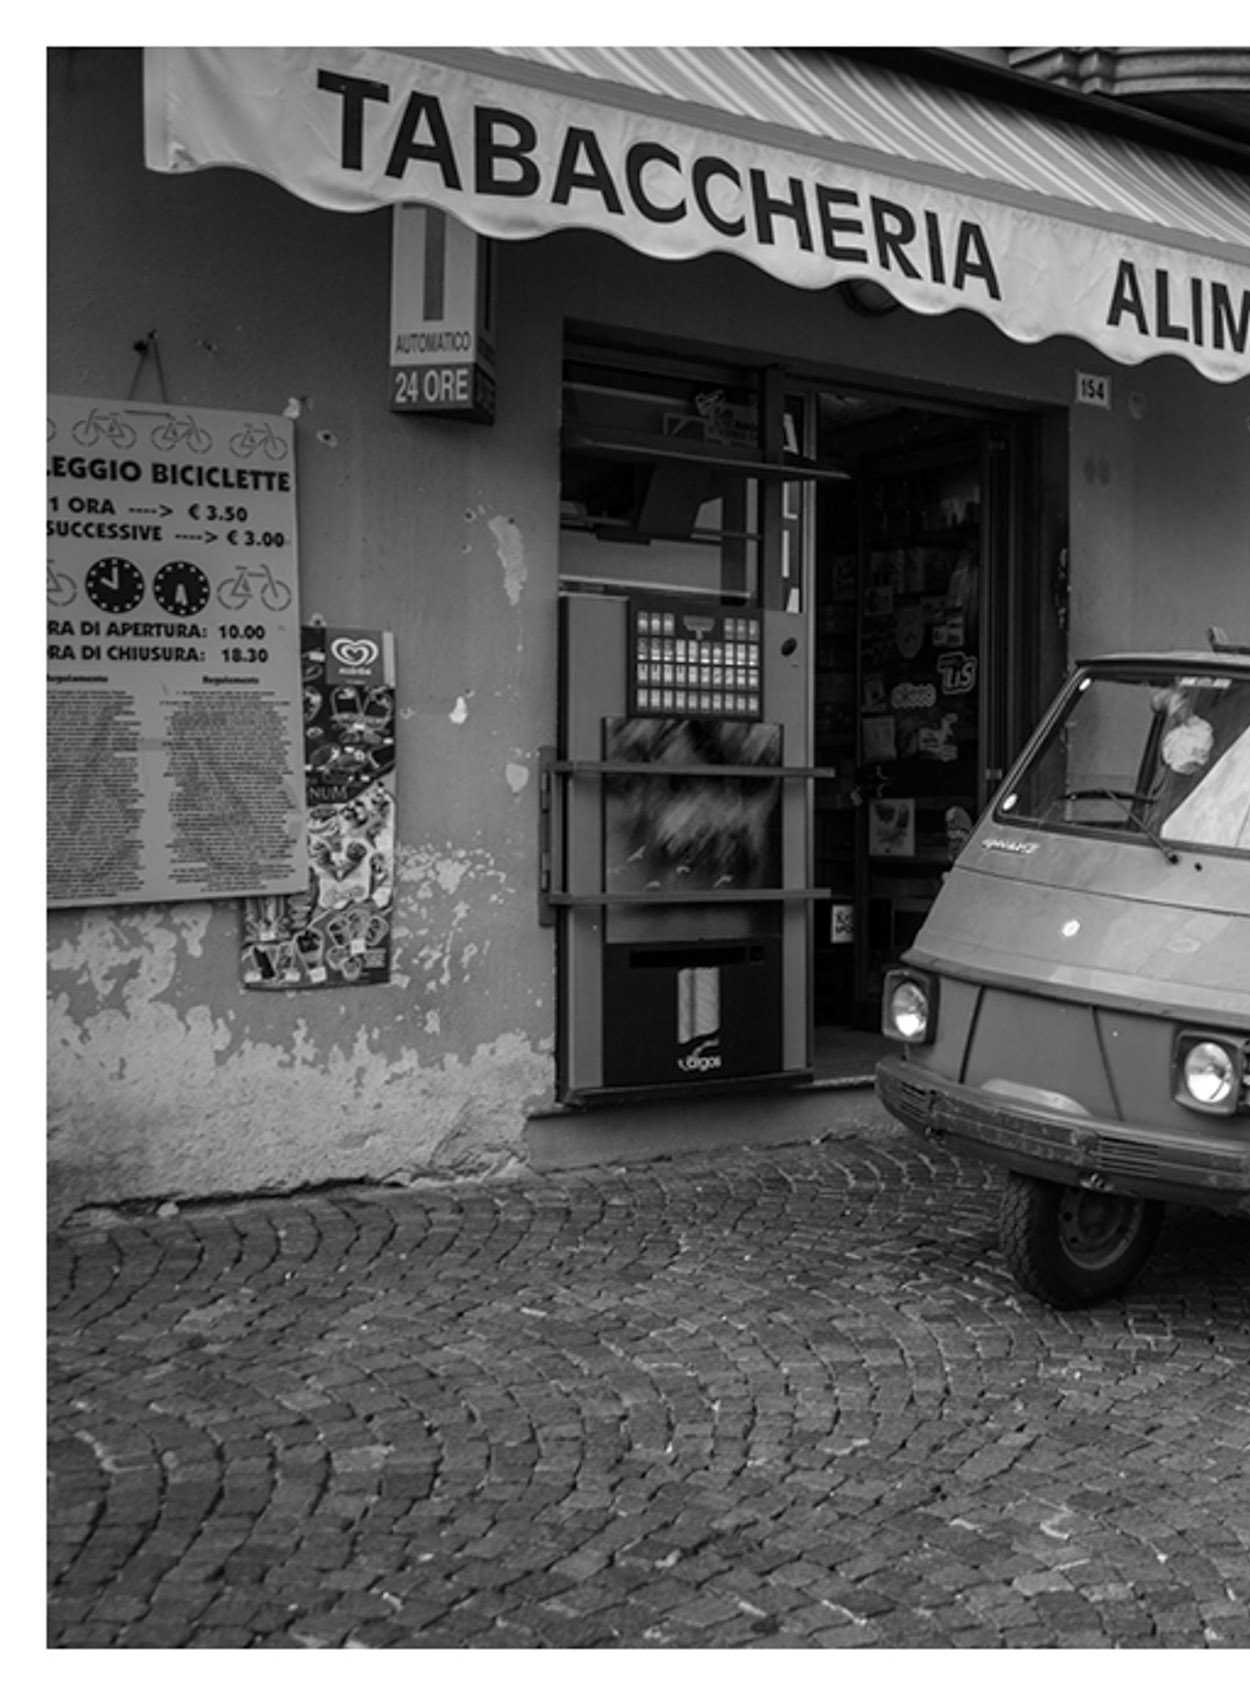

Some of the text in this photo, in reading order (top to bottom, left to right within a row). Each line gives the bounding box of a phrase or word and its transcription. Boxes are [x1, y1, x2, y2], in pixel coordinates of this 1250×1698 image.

[317, 69, 1002, 300] TABACCHERIA
[396, 330, 471, 354] AUTOMATICO
[395, 371, 419, 403] 24
[424, 369, 469, 402] ORE
[1081, 379, 1105, 400] 154
[47, 456, 291, 492] EGGIO BICICLETTE
[49, 496, 248, 522] 1 ORA € 3.50
[47, 520, 285, 548] SUCCESSIVE € 3.00
[47, 620, 266, 641] RA DI APERTURA: 10.00
[47, 645, 269, 663] RA DI CHIUSURA: 18.30
